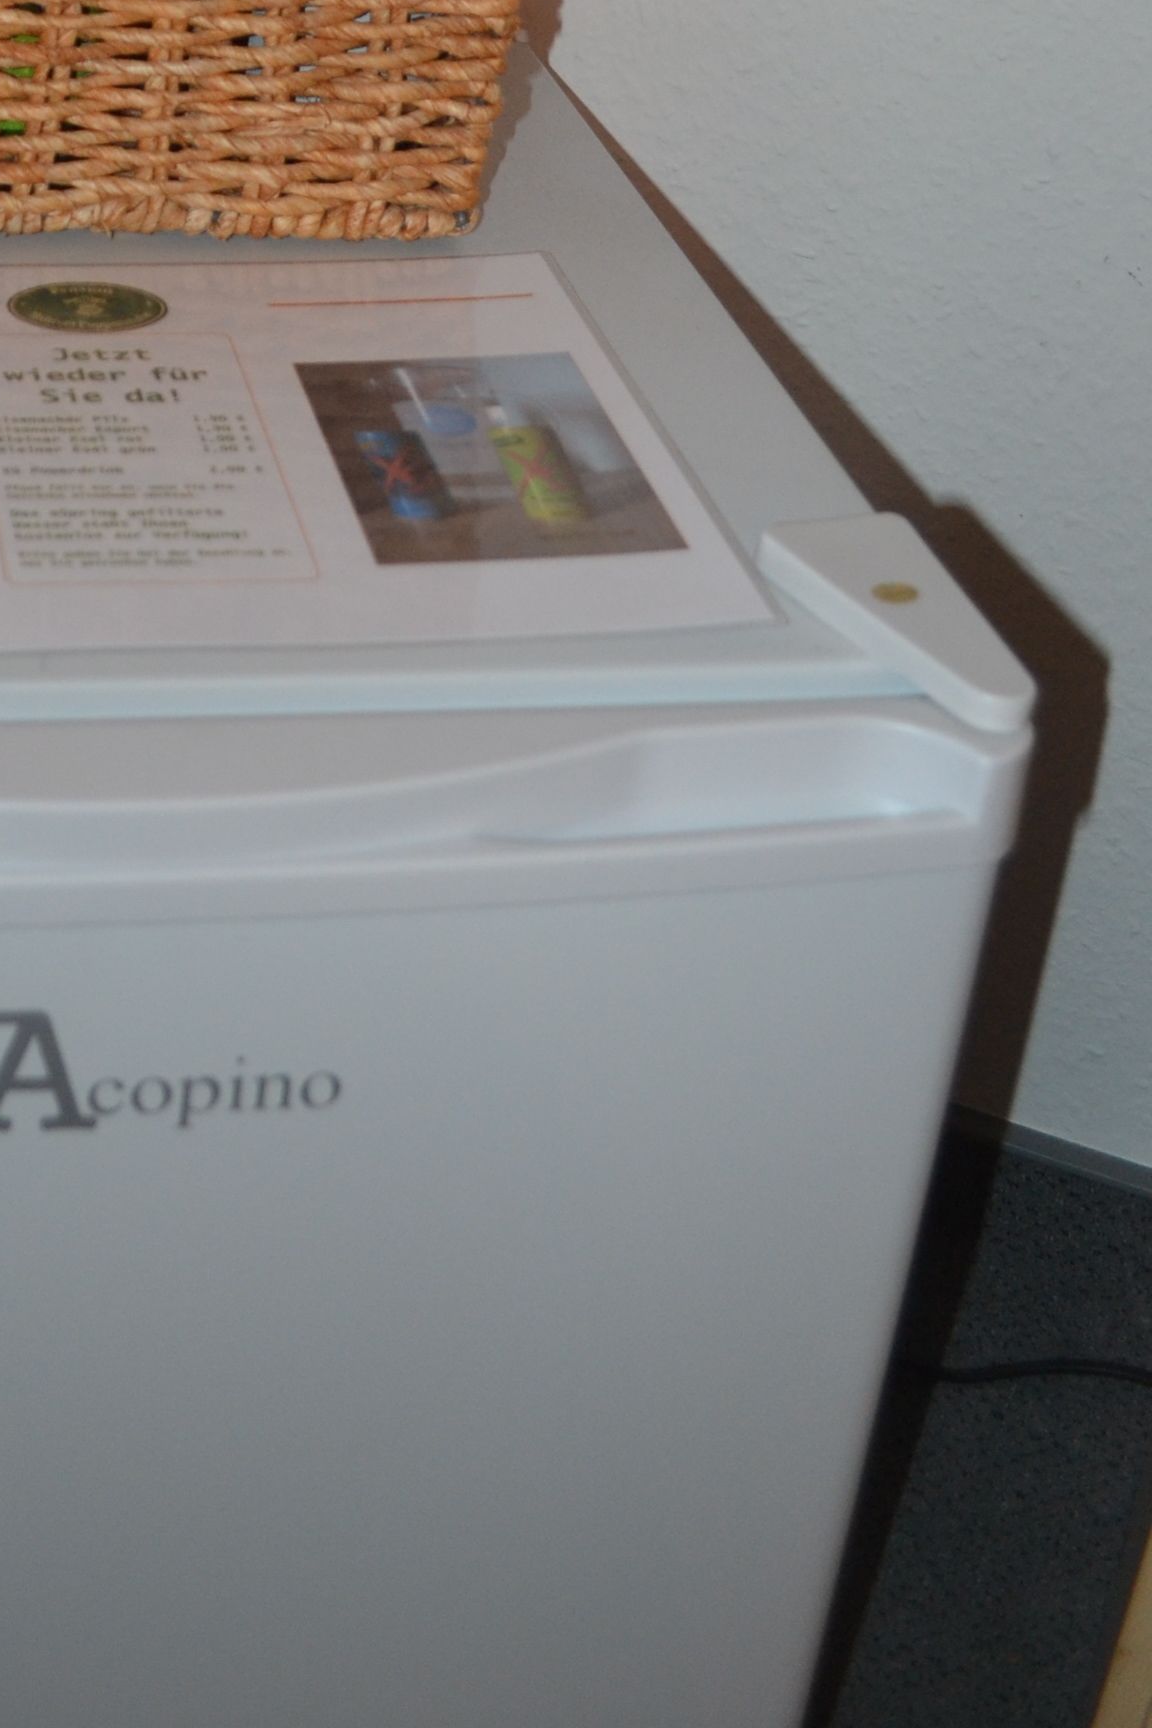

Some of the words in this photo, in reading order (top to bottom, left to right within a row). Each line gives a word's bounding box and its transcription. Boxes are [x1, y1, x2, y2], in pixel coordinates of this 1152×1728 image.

[52, 347, 152, 361] Jetzt
[2, 367, 127, 382] wieder
[151, 366, 208, 382] für
[40, 388, 103, 404] Sie
[124, 387, 181, 403] da!
